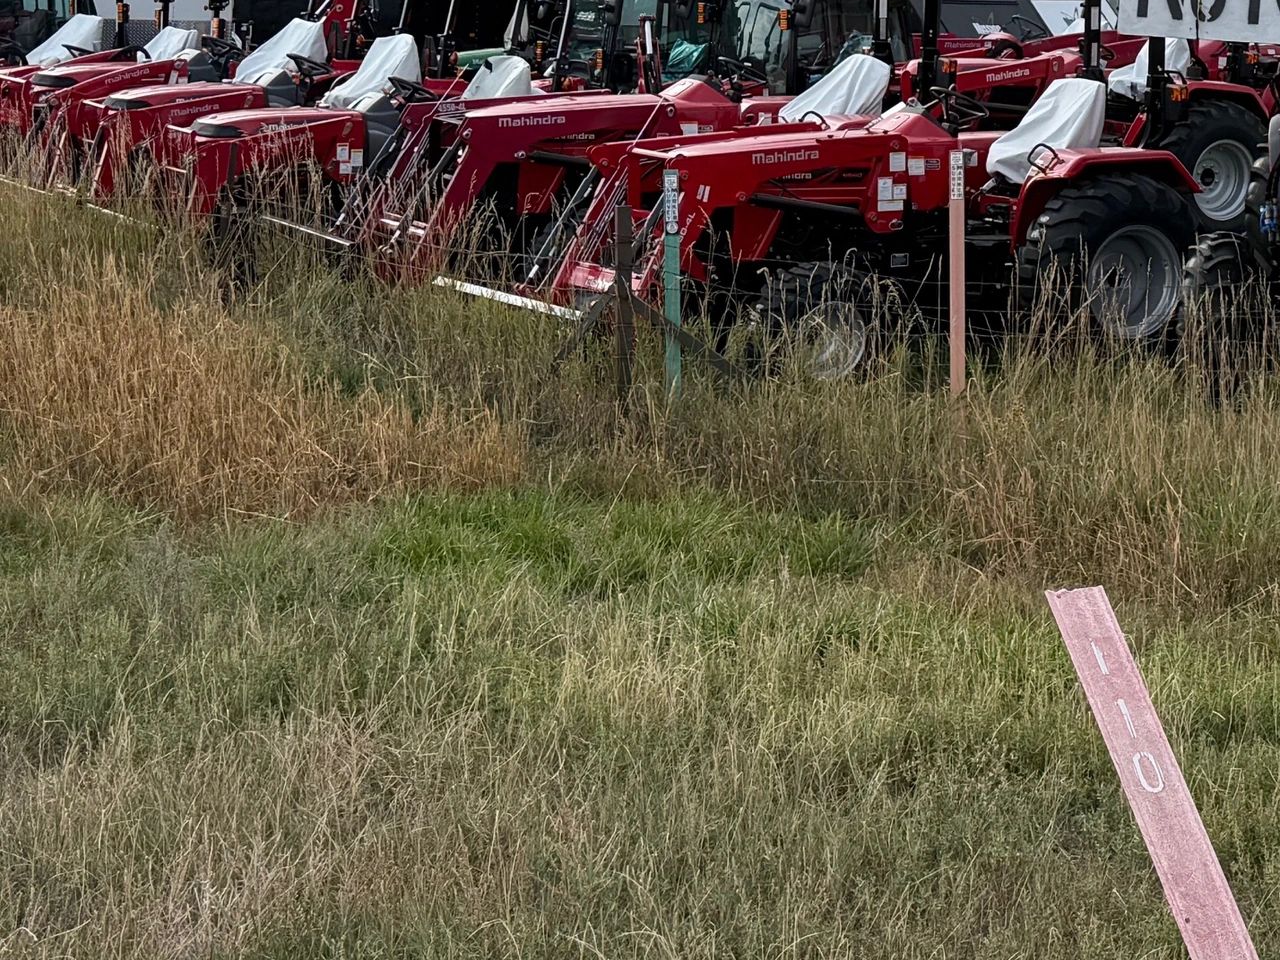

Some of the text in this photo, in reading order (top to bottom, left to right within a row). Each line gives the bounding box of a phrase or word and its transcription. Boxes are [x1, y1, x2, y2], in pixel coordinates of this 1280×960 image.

[986, 69, 1030, 82] Mahindra
[498, 114, 566, 128] Mahindra
[751, 149, 820, 165] Mahindra
